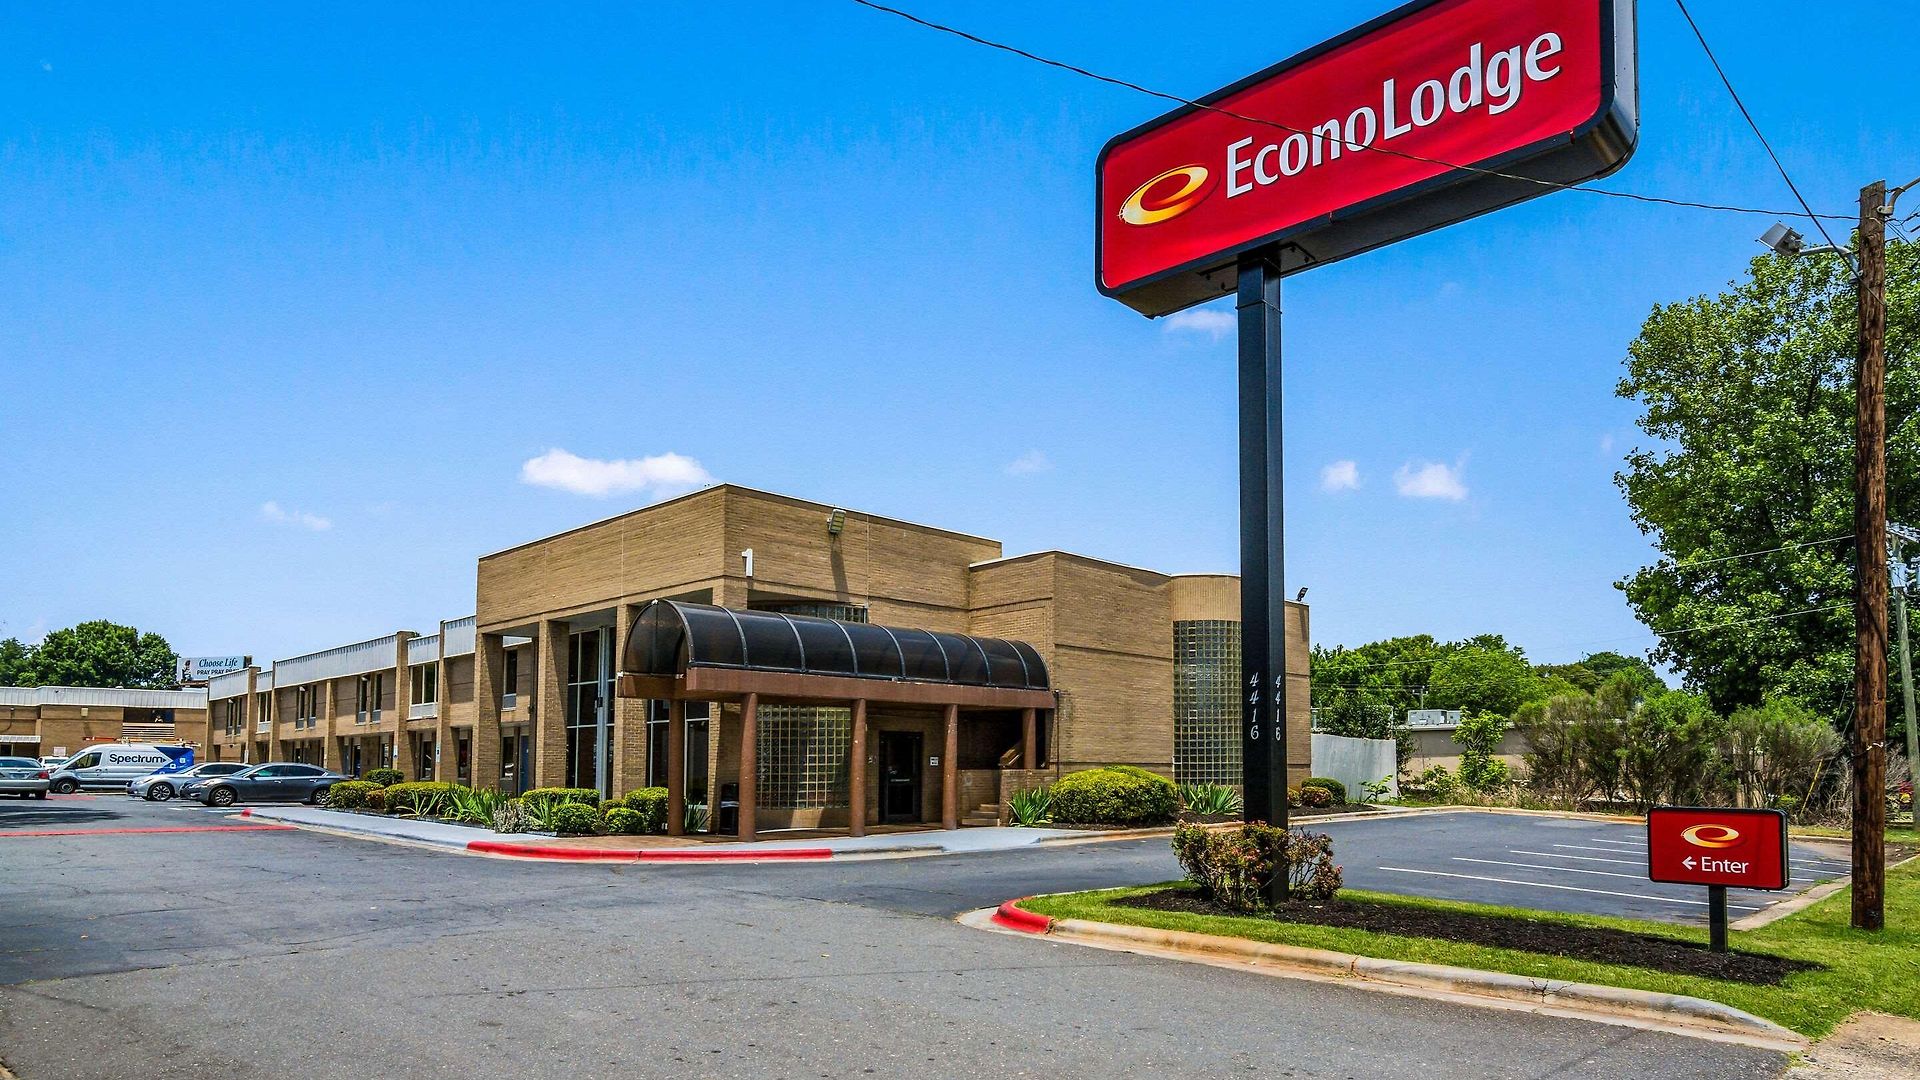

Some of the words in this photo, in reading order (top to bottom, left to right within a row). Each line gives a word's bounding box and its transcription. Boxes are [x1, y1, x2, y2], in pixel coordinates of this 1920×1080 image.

[741, 548, 753, 577] 1
[198, 657, 223, 668] Choose
[224, 656, 238, 668] Life
[1249, 671, 1260, 740] 4416
[109, 753, 163, 764] Spectrum
[1701, 856, 1750, 874] Enter
